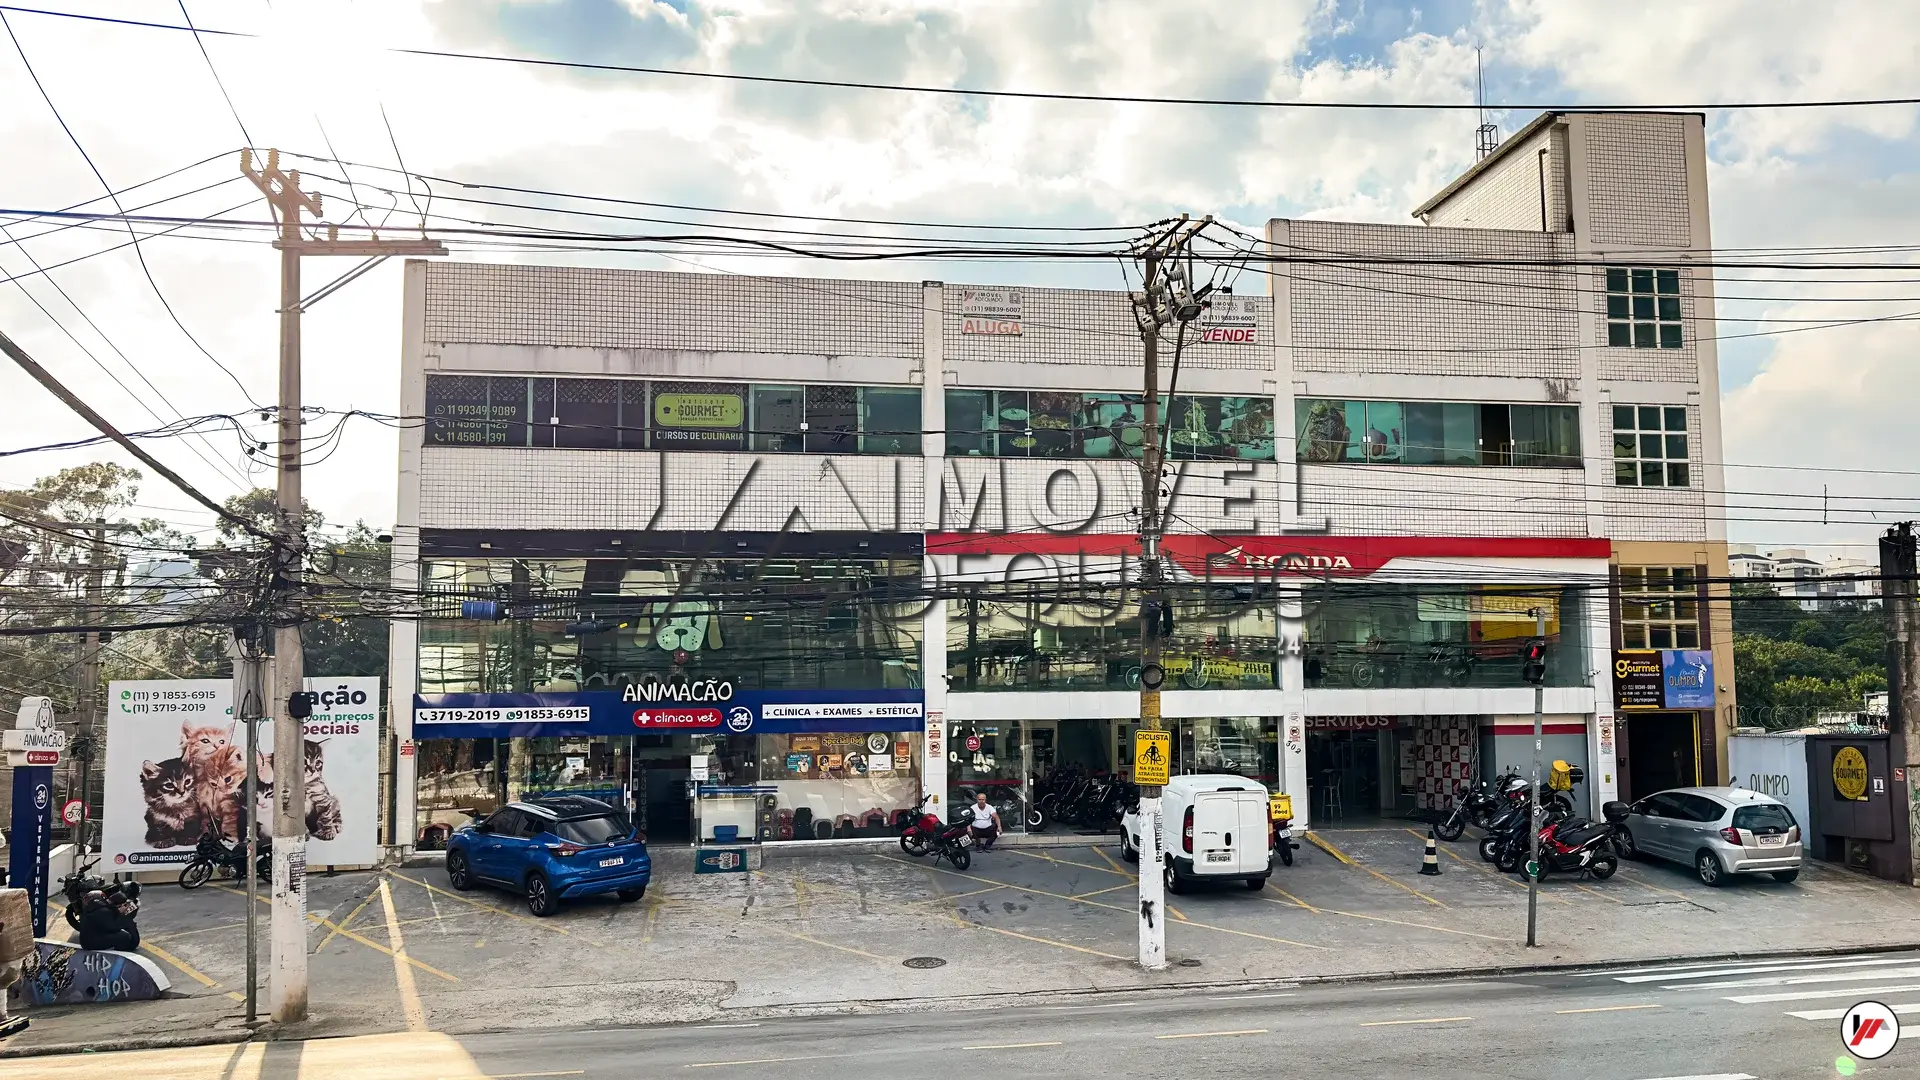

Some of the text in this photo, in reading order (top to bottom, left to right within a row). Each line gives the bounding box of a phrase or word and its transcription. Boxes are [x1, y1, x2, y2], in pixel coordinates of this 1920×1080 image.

[964, 320, 1020, 334] ALUGA
[1202, 329, 1256, 342] VENDE
[678, 405, 724, 417] GOURMET
[656, 431, 688, 440] CURSOS
[690, 432, 700, 440] DE
[1244, 555, 1354, 570] HONDA
[1669, 676, 1696, 686] OLIMPO
[133, 691, 216, 701] (11) 9 1853-6915
[133, 703, 206, 713] (11) 3719-2019
[773, 706, 811, 716] CLÍNICA
[876, 706, 919, 715] ESTÉTICA
[334, 713, 374, 724] preços
[430, 709, 588, 721] 3719-2019 91853-6915
[697, 712, 717, 722] vet
[734, 713, 748, 722] 24
[1305, 716, 1390, 729] SERVIÇOS
[1286, 740, 1301, 754] 302
[1836, 768, 1864, 779] GOURMET
[1750, 774, 1789, 796] OLIMPO
[37, 790, 45, 799] 24
